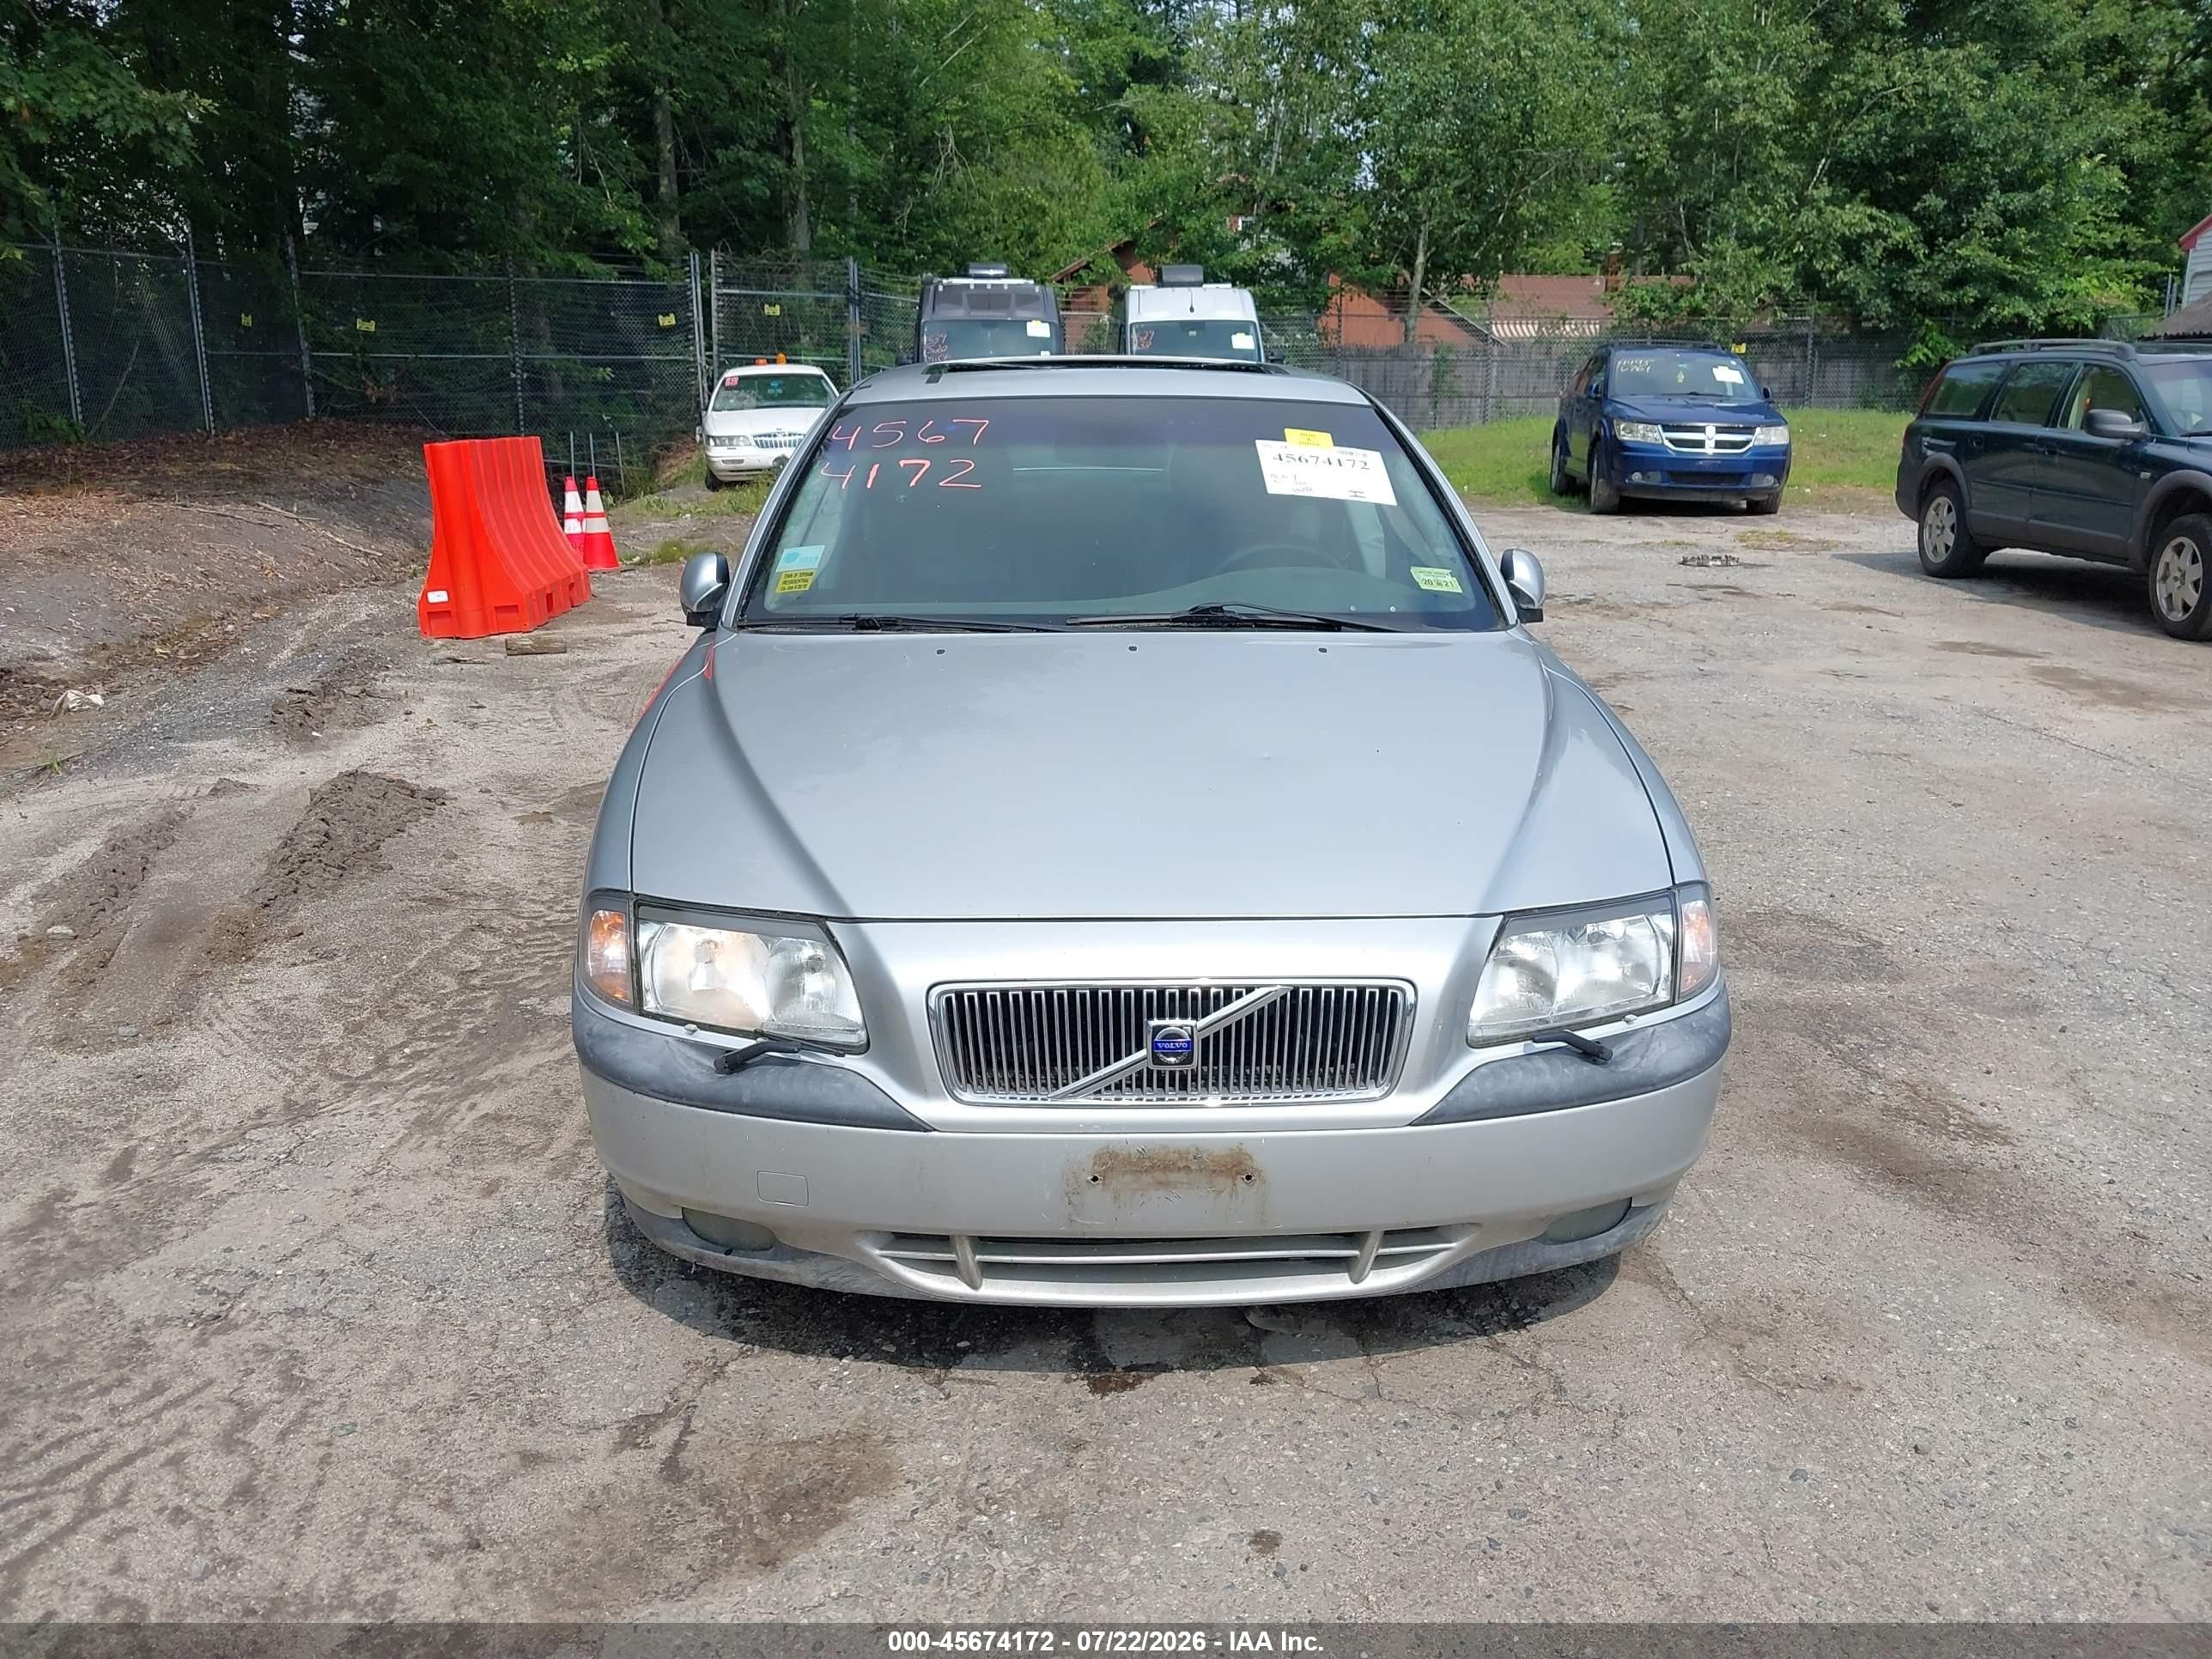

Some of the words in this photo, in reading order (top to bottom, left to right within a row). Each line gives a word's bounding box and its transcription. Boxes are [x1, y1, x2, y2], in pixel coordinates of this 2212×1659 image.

[832, 419, 989, 450] 4567
[821, 459, 981, 489] 4172
[1273, 453, 1370, 471] 45674172
